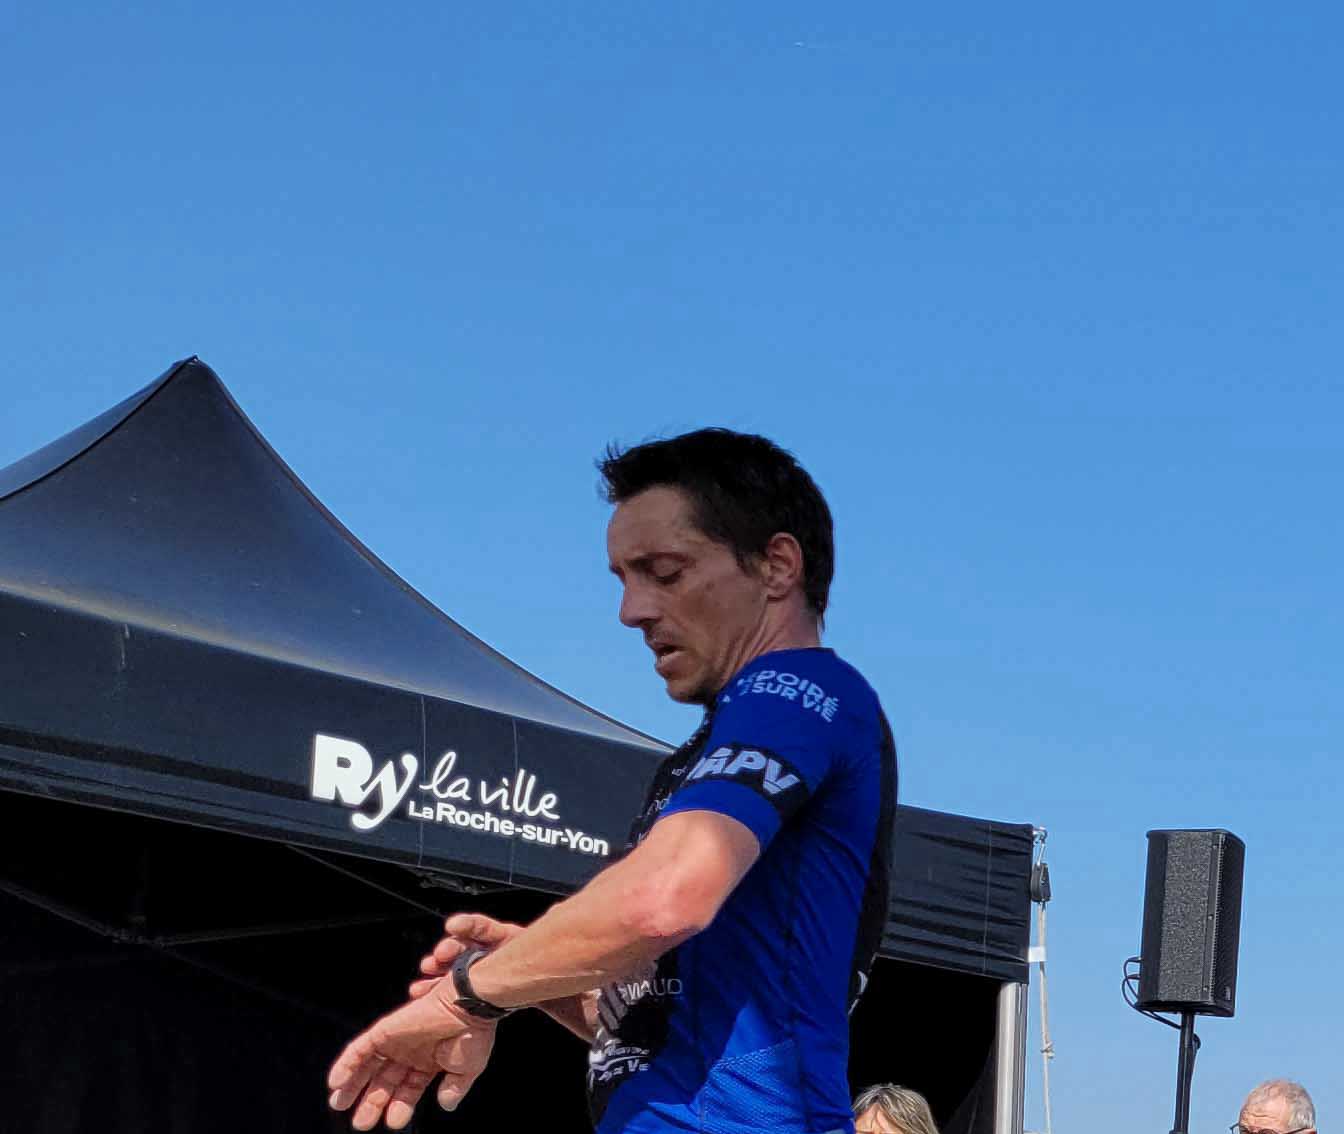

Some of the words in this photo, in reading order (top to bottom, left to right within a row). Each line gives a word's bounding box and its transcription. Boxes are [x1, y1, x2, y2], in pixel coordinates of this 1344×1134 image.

[419, 751, 471, 801] la
[480, 768, 561, 820] ville
[408, 800, 434, 821] La
[435, 801, 609, 856] Roche-sur-Yon
